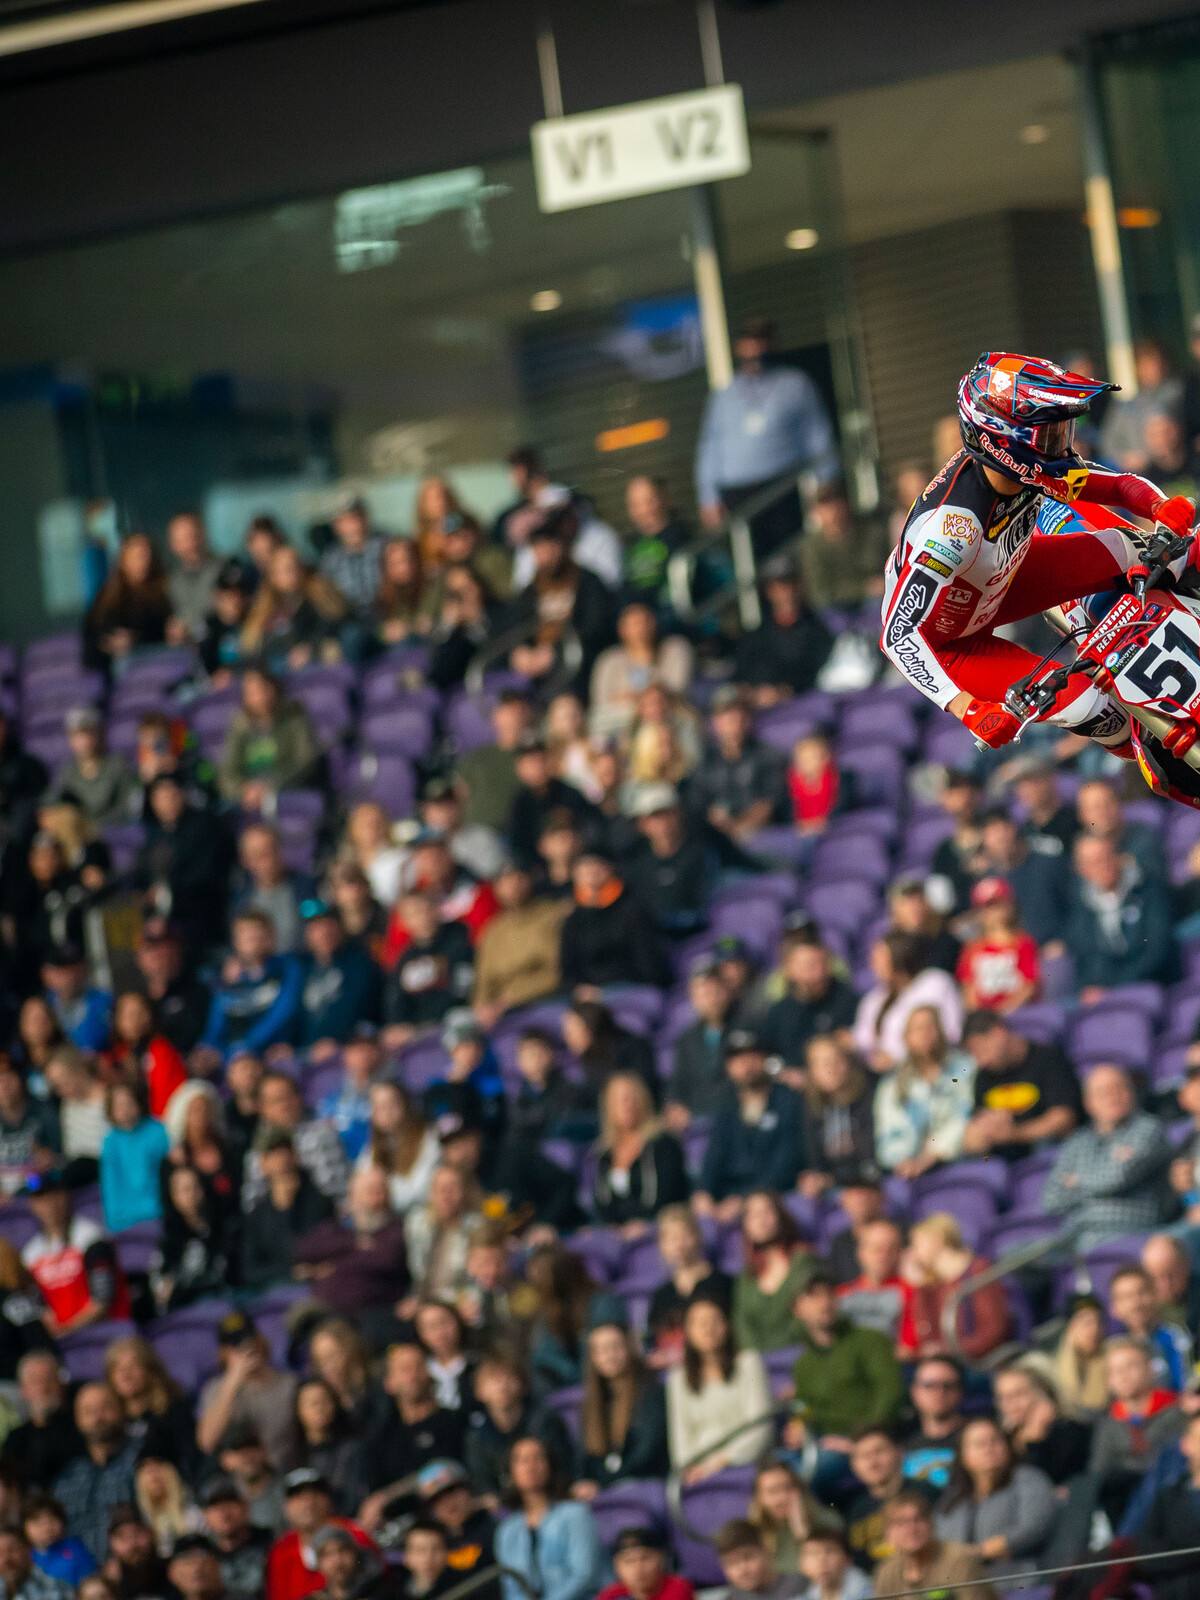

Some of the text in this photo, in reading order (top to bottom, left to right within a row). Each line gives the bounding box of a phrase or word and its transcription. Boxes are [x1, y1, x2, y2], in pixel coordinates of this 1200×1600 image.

[554, 107, 722, 185] V1 V2
[979, 432, 1006, 459] Red
[1000, 448, 1030, 477] Bull
[945, 514, 973, 529] WOW
[933, 543, 961, 565] MOTOREX
[899, 583, 927, 619] Troy
[1088, 598, 1132, 645] RENTHAL
[1096, 605, 1140, 653] RENTHAL
[894, 636, 940, 693] Designs
